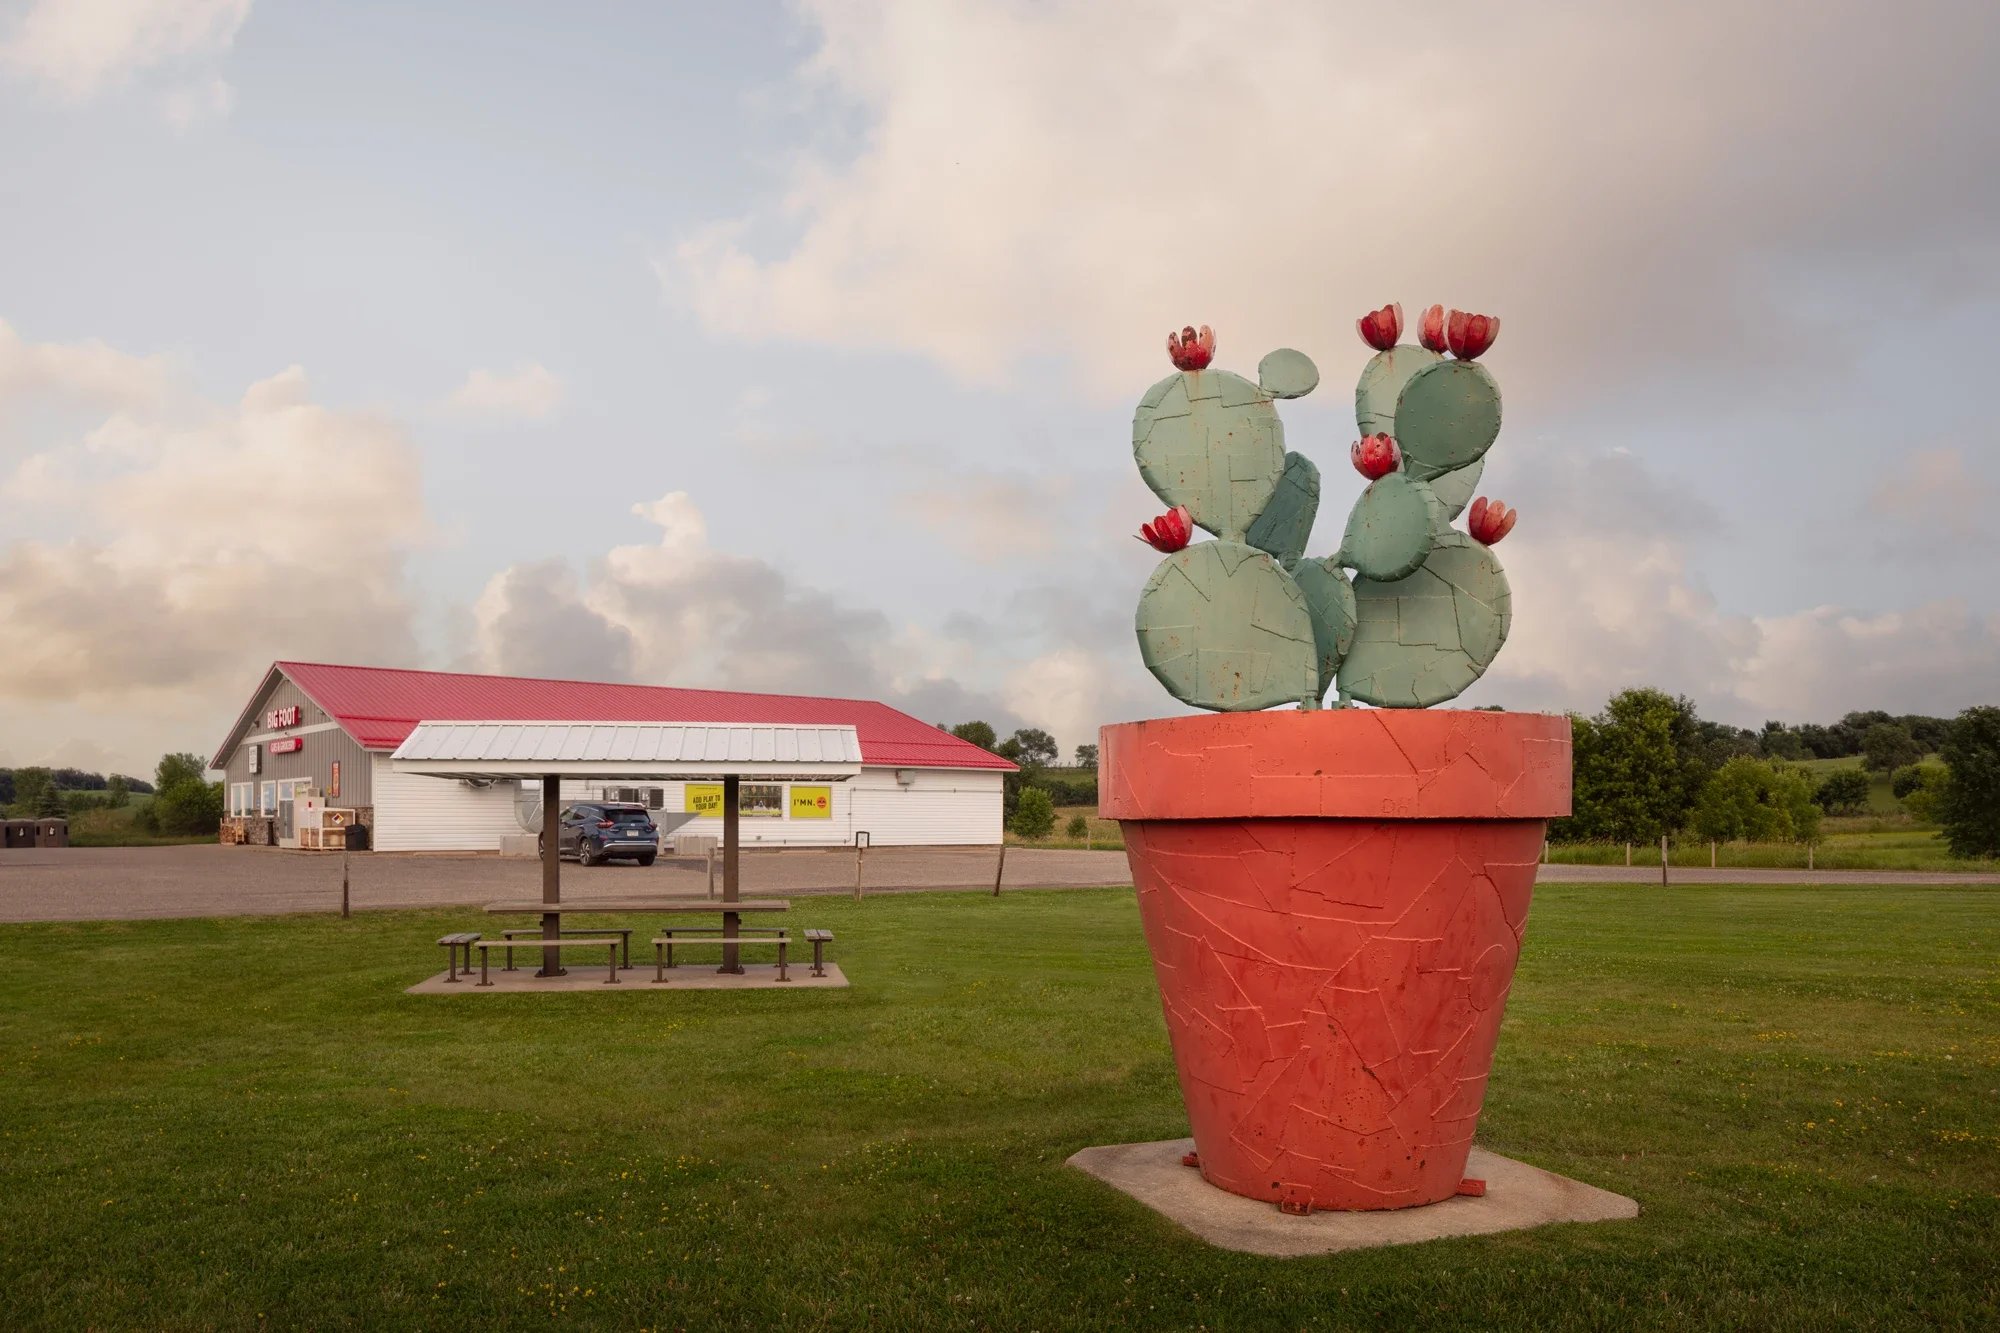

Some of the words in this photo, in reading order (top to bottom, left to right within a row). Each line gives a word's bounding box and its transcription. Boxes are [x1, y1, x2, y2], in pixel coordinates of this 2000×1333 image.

[267, 710, 278, 729] BIG
[278, 706, 296, 727] FOOT
[693, 796, 702, 804] ADD
[702, 795, 714, 803] PLAY
[715, 794, 721, 802] TO
[695, 803, 708, 811] YOUR
[708, 801, 719, 810] DAY!
